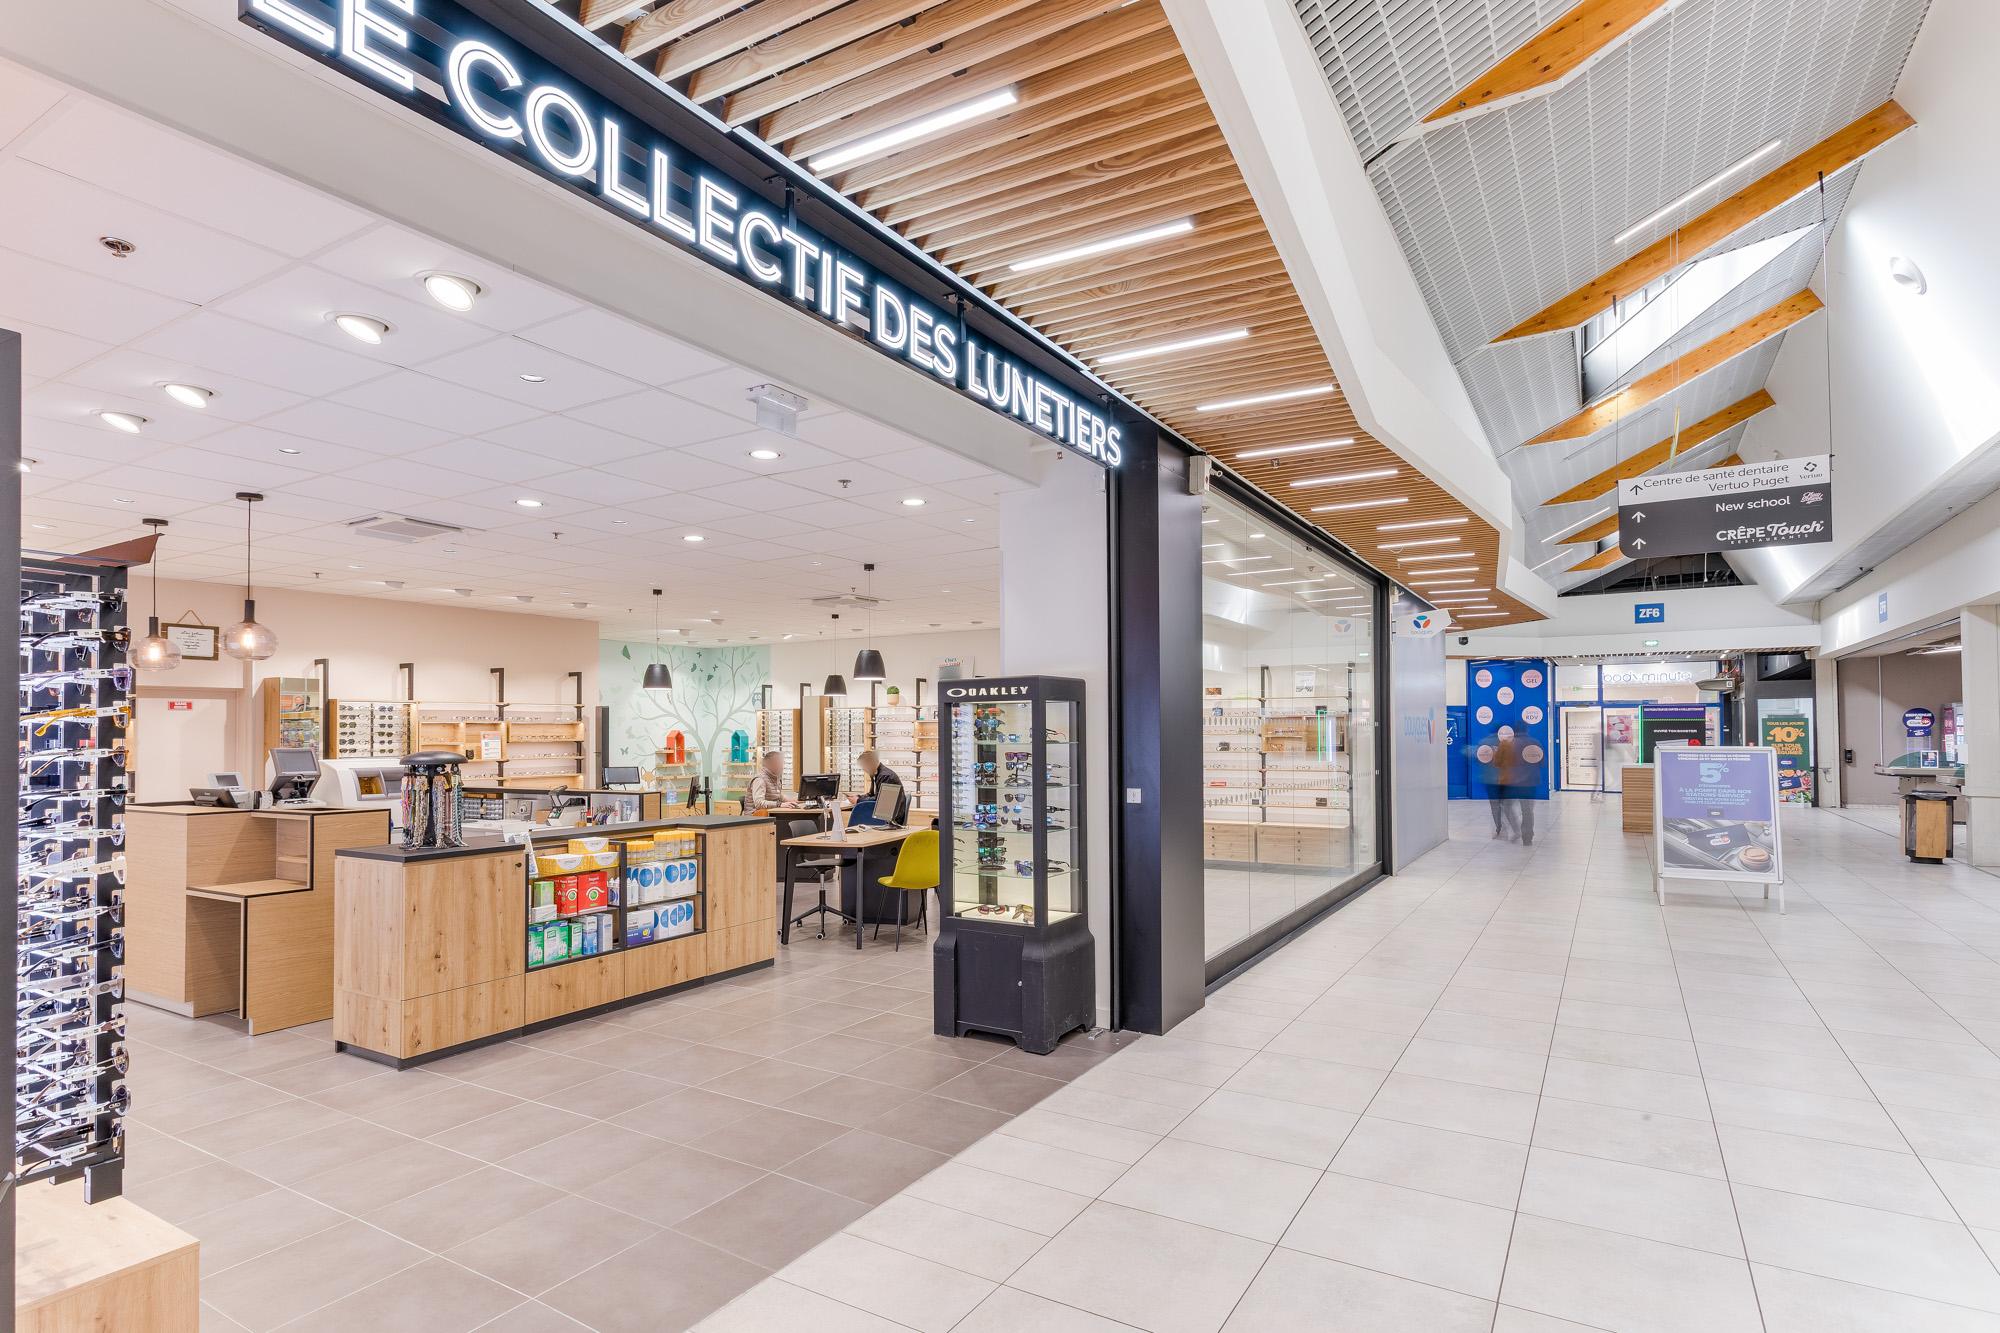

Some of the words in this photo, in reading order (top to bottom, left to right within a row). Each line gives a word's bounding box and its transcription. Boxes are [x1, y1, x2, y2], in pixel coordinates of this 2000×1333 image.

[448, 40, 864, 323] COLLECTIF
[876, 285, 957, 379] DES
[968, 341, 1122, 467] LUNETIERS
[1643, 476, 1684, 488] Centre
[1685, 473, 1699, 483] de
[1702, 468, 1735, 480] santé
[1738, 463, 1789, 477] dentaire
[1709, 479, 1750, 492] Vertuo
[1753, 475, 1790, 490] Puget
[1715, 500, 1745, 513] New
[1747, 495, 1791, 509] school
[1716, 525, 1766, 541] CRÊPE
[1766, 520, 1825, 537] Touch
[1639, 607, 1660, 618] ZF6
[968, 686, 1029, 697] OAKLEY
[1767, 726, 1806, 743] -10%
[1699, 762, 1730, 784] 5%
